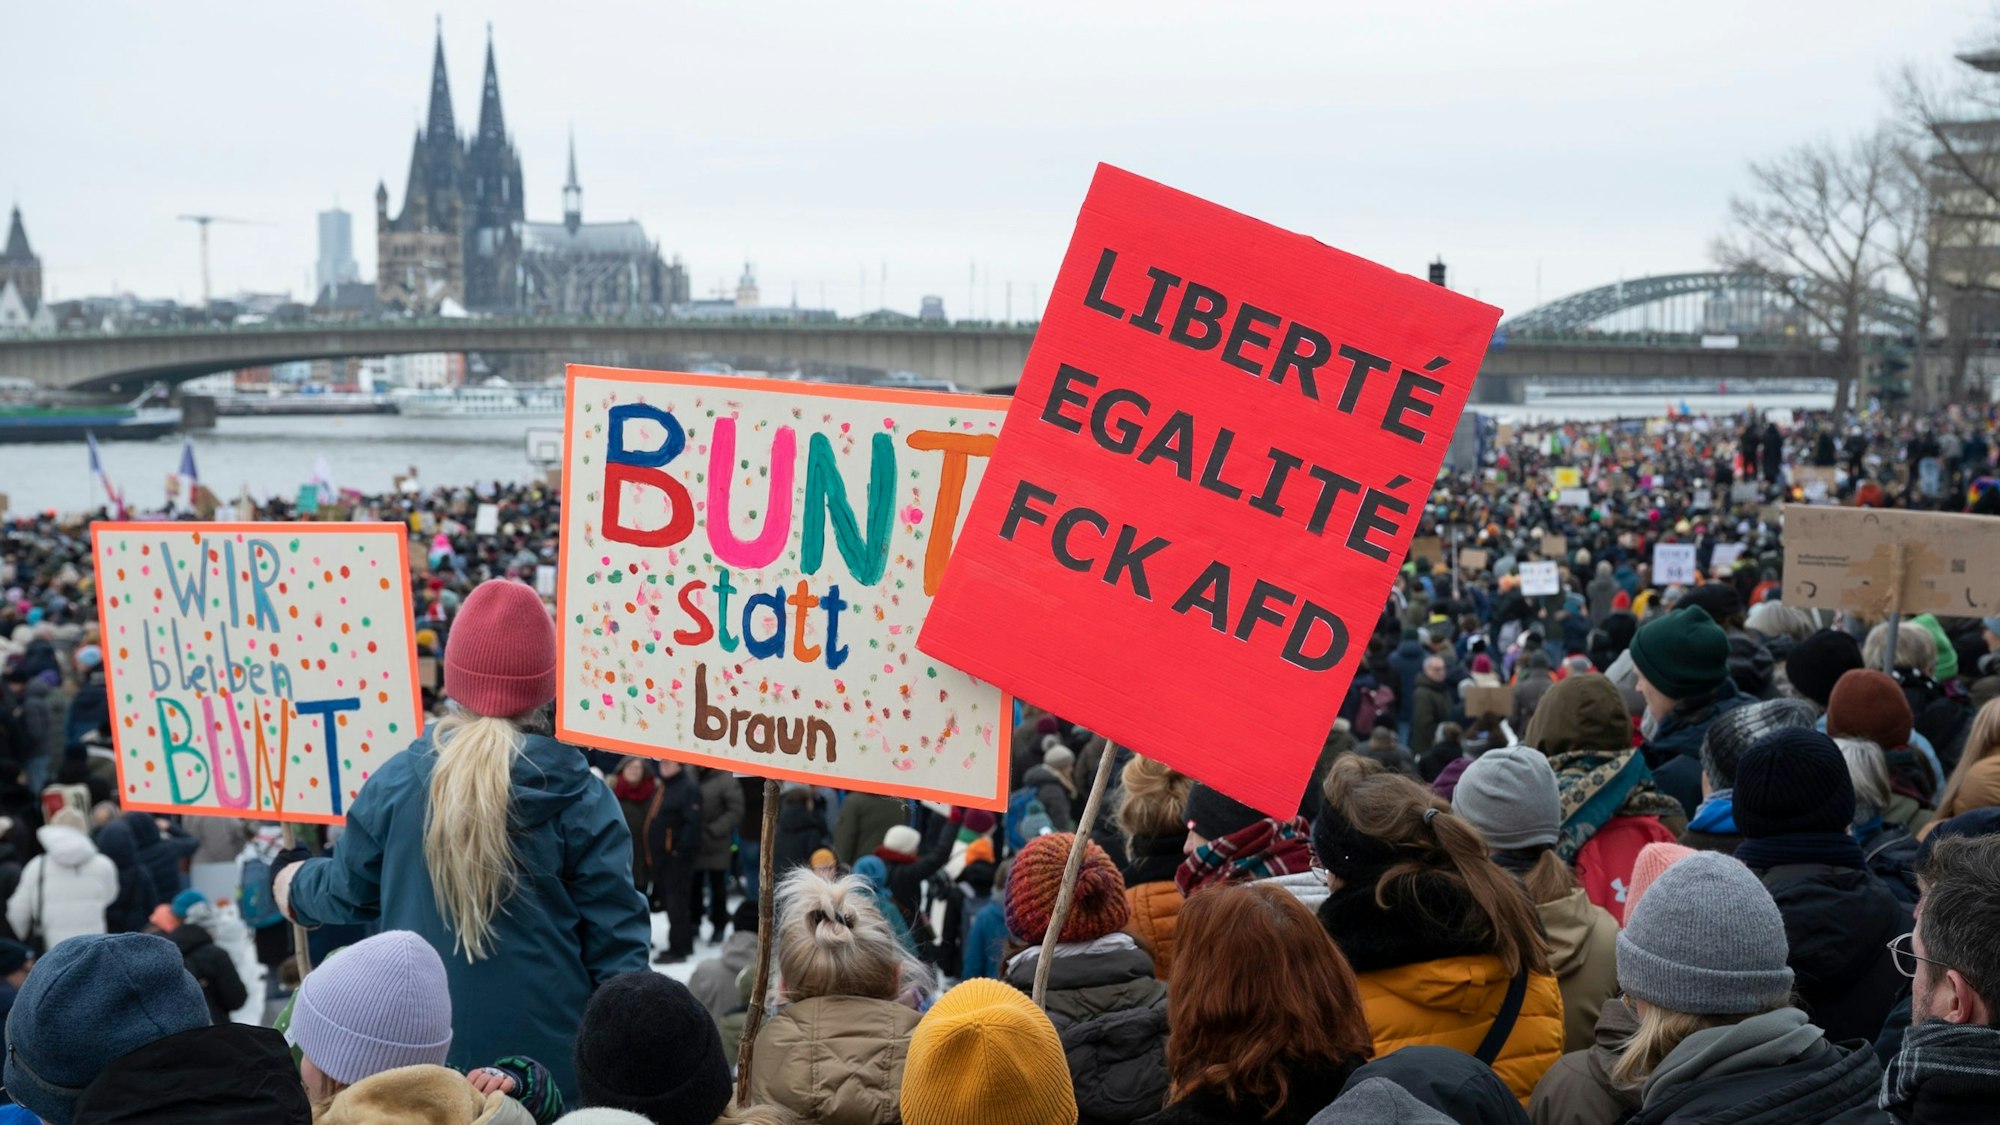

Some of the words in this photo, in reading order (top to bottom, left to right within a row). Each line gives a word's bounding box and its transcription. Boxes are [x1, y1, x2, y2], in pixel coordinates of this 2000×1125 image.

[1084, 248, 1450, 444] LIBERTÉ
[602, 403, 1000, 597] BUNT
[1039, 363, 1410, 562] EGALITÉ
[160, 539, 281, 633] WIR
[674, 568, 849, 670] statt
[999, 480, 1172, 601] FCK
[1171, 560, 1350, 672] AFD
[143, 618, 293, 701] bleiben
[693, 663, 837, 762] braun
[156, 692, 361, 816] BUNT
